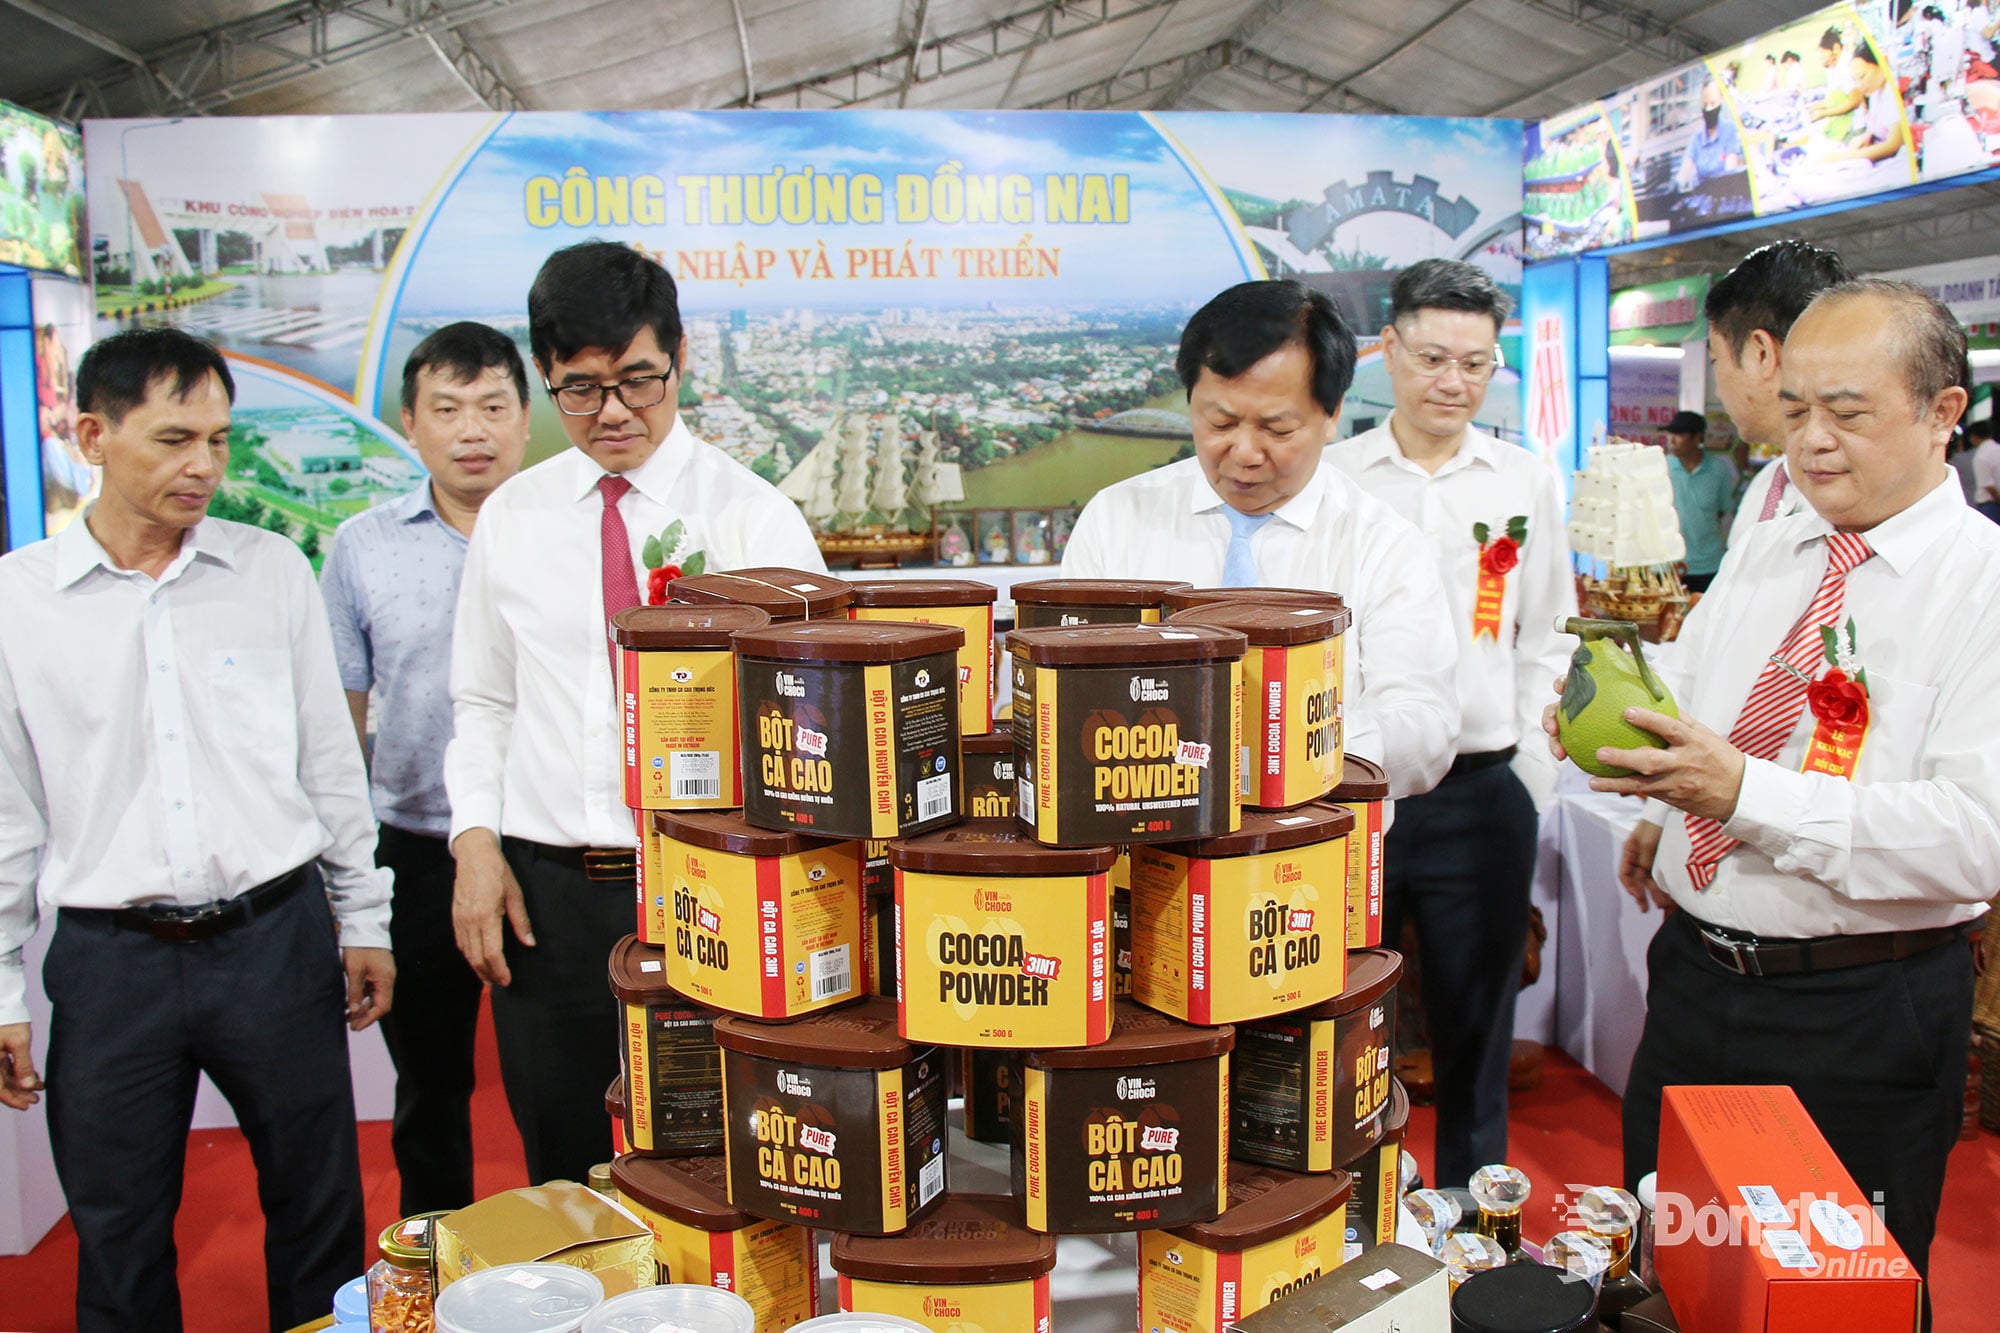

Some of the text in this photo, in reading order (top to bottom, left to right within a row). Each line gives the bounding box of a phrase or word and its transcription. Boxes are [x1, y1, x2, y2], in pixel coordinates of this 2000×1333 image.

[184, 200, 221, 214] KHU
[525, 160, 1130, 228] CÔNG THƯƠNG ĐỒNG NAI
[1326, 186, 1432, 223] AMATA
[677, 241, 776, 287] NHẬP
[788, 239, 834, 280] VÀ
[845, 238, 943, 279] PHÁT
[952, 232, 1061, 279] TRIỂN
[783, 674, 794, 686] VIN
[784, 685, 806, 698] CHOCO
[1141, 679, 1155, 690] VIN
[1141, 689, 1169, 702] CHOCO
[1307, 687, 1338, 725] COCOA
[759, 710, 793, 755] BỘT
[801, 731, 823, 750] PURE
[1095, 724, 1179, 761] COCOA
[1267, 681, 1282, 775] 3IN1 COCOA POWDER
[1306, 720, 1341, 762] POWDER
[870, 690, 893, 815] BỘT CA CAO NGUYÊN CHẤT
[1041, 703, 1051, 809] PURE COCOA POWDER
[1181, 745, 1206, 760] PURE
[762, 754, 833, 793] CA CAO
[1095, 763, 1201, 800] POWDER
[1095, 798, 1199, 813] 100% NATURAL UNSWEETENED COCOA
[1147, 820, 1163, 831] 400
[691, 866, 707, 880] CHOCO
[1282, 863, 1293, 873] VIN
[1282, 871, 1302, 884] CHOCO
[1370, 831, 1380, 917] 3IN1 COCOA POWDER
[674, 887, 698, 928] BỘT
[985, 891, 998, 902] VIN
[985, 902, 1012, 912] CHOCO
[700, 909, 718, 931] 3IN1
[1250, 900, 1289, 942] BỘT
[1291, 912, 1312, 928] 3IN1
[676, 926, 729, 971] CA CAO
[762, 901, 778, 977] BỘT CA CAO 3IN1
[939, 931, 1024, 967] COCOA
[1192, 894, 1205, 990] 3IN1 COCOA POWDER
[1026, 957, 1055, 977] 3IN1
[1090, 920, 1105, 1002] BỘT CA CAO 3IN1
[1249, 933, 1320, 978] CA CAO
[939, 970, 1048, 1006] POWDER
[1287, 992, 1297, 1001] 500
[630, 1022, 642, 1040] BỘT
[632, 1041, 642, 1052] CA
[993, 1029, 1013, 1038] 500 G
[632, 1055, 643, 1071] CAO
[786, 1072, 798, 1084] VIN
[1355, 1045, 1377, 1087] BỘT
[634, 1074, 647, 1106] NGUYÊN
[786, 1083, 812, 1097] CHOCO
[1128, 1078, 1141, 1089] VIN
[1128, 1087, 1156, 1100] CHOCO
[1315, 1050, 1329, 1142] PURE COCOA POWDER
[1373, 1069, 1389, 1108] CAO
[756, 1106, 797, 1150] BỘT
[806, 1129, 831, 1147] PURE
[1088, 1115, 1138, 1159] BỘT
[1148, 1129, 1174, 1144] PURE
[884, 1091, 903, 1210] BỘT CA CAO NGUYÊN CHẤT
[1029, 1100, 1040, 1199] PURE COCOA POWDER
[758, 1146, 841, 1189] CA CAO
[1088, 1153, 1182, 1192] CA CAO
[1136, 1209, 1158, 1220] 400 G
[1383, 1171, 1393, 1233] COCOA POWDER
[1301, 1238, 1309, 1248] VIN
[1301, 1242, 1316, 1257] CHOCO
[934, 1298, 947, 1308] VIN
[934, 1307, 961, 1318] CHOCO
[1222, 1281, 1236, 1319] POWDER
